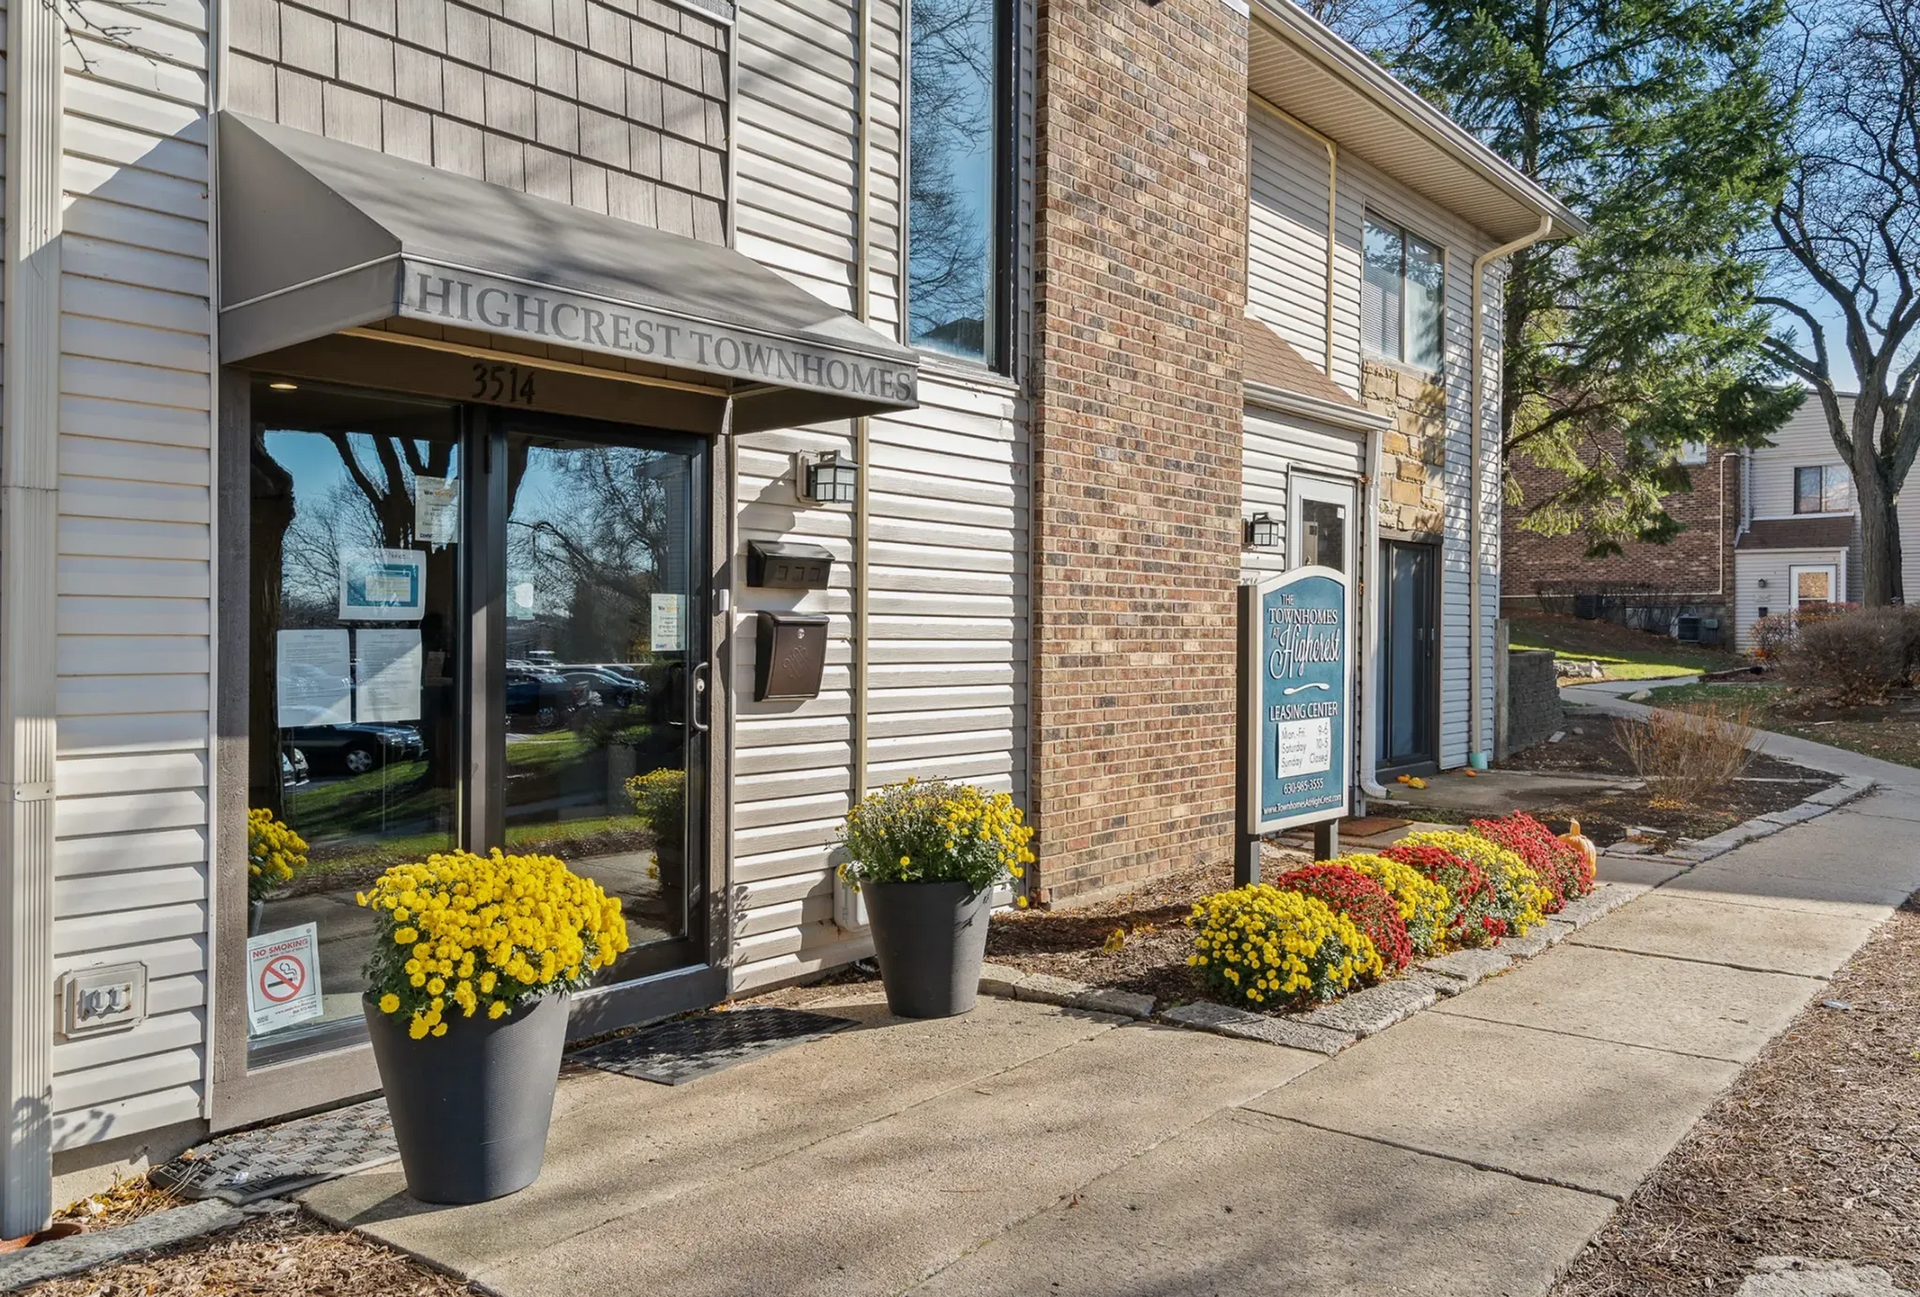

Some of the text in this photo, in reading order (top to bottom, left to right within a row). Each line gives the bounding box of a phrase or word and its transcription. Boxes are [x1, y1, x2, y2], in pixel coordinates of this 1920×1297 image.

[415, 272, 912, 402] HIGHCREST TOWNHOMES
[471, 362, 536, 405] 3514
[1282, 594, 1295, 606] THE
[1268, 607, 1338, 625] TOWNHOMES
[1269, 623, 1342, 679] Highcrest
[1268, 700, 1339, 721] LEASING CENTER
[1317, 721, 1329, 736] 9-6
[1281, 737, 1329, 755] Saturday 10-5
[1281, 751, 1329, 769] Sunday Closed
[252, 948, 267, 959] NO
[268, 938, 309, 954] SMOKING
